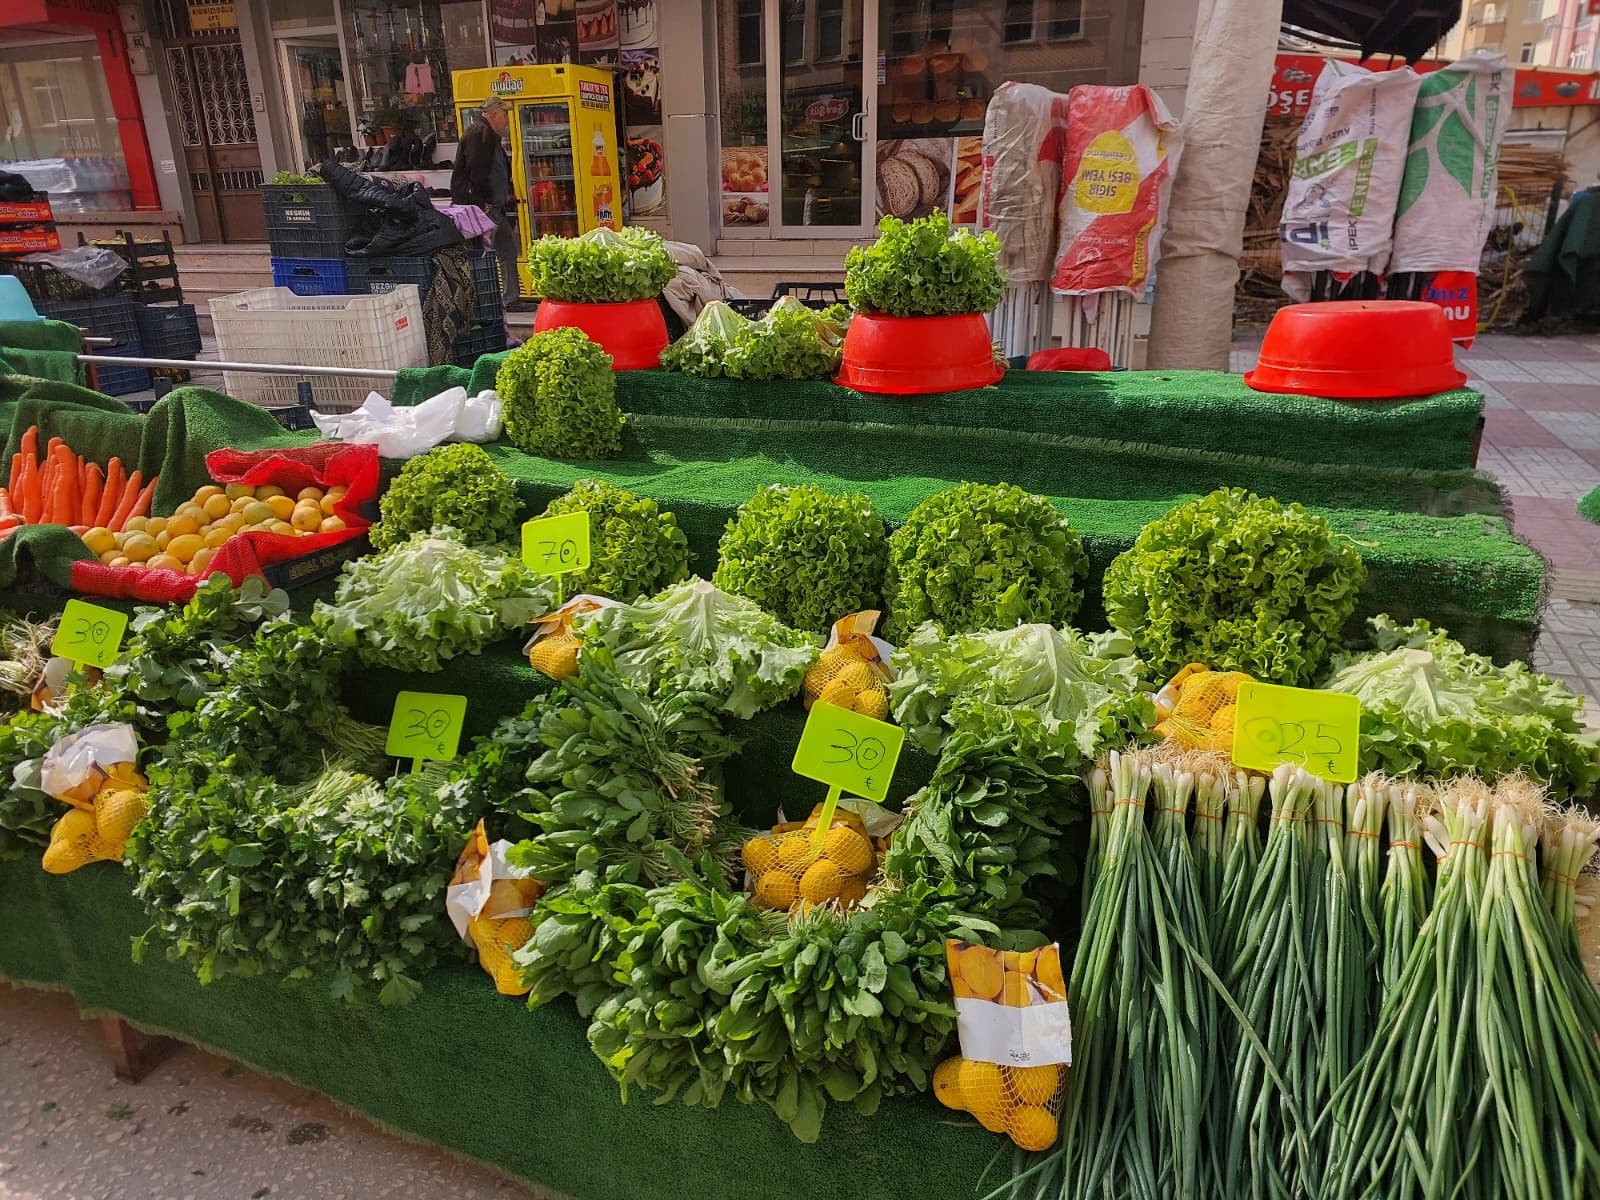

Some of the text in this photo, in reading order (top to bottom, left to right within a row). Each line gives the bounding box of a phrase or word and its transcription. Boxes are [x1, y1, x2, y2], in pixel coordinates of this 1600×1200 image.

[538, 539, 577, 567] 70
[67, 618, 110, 645] 30
[404, 709, 451, 739] 30
[823, 728, 886, 771] 30
